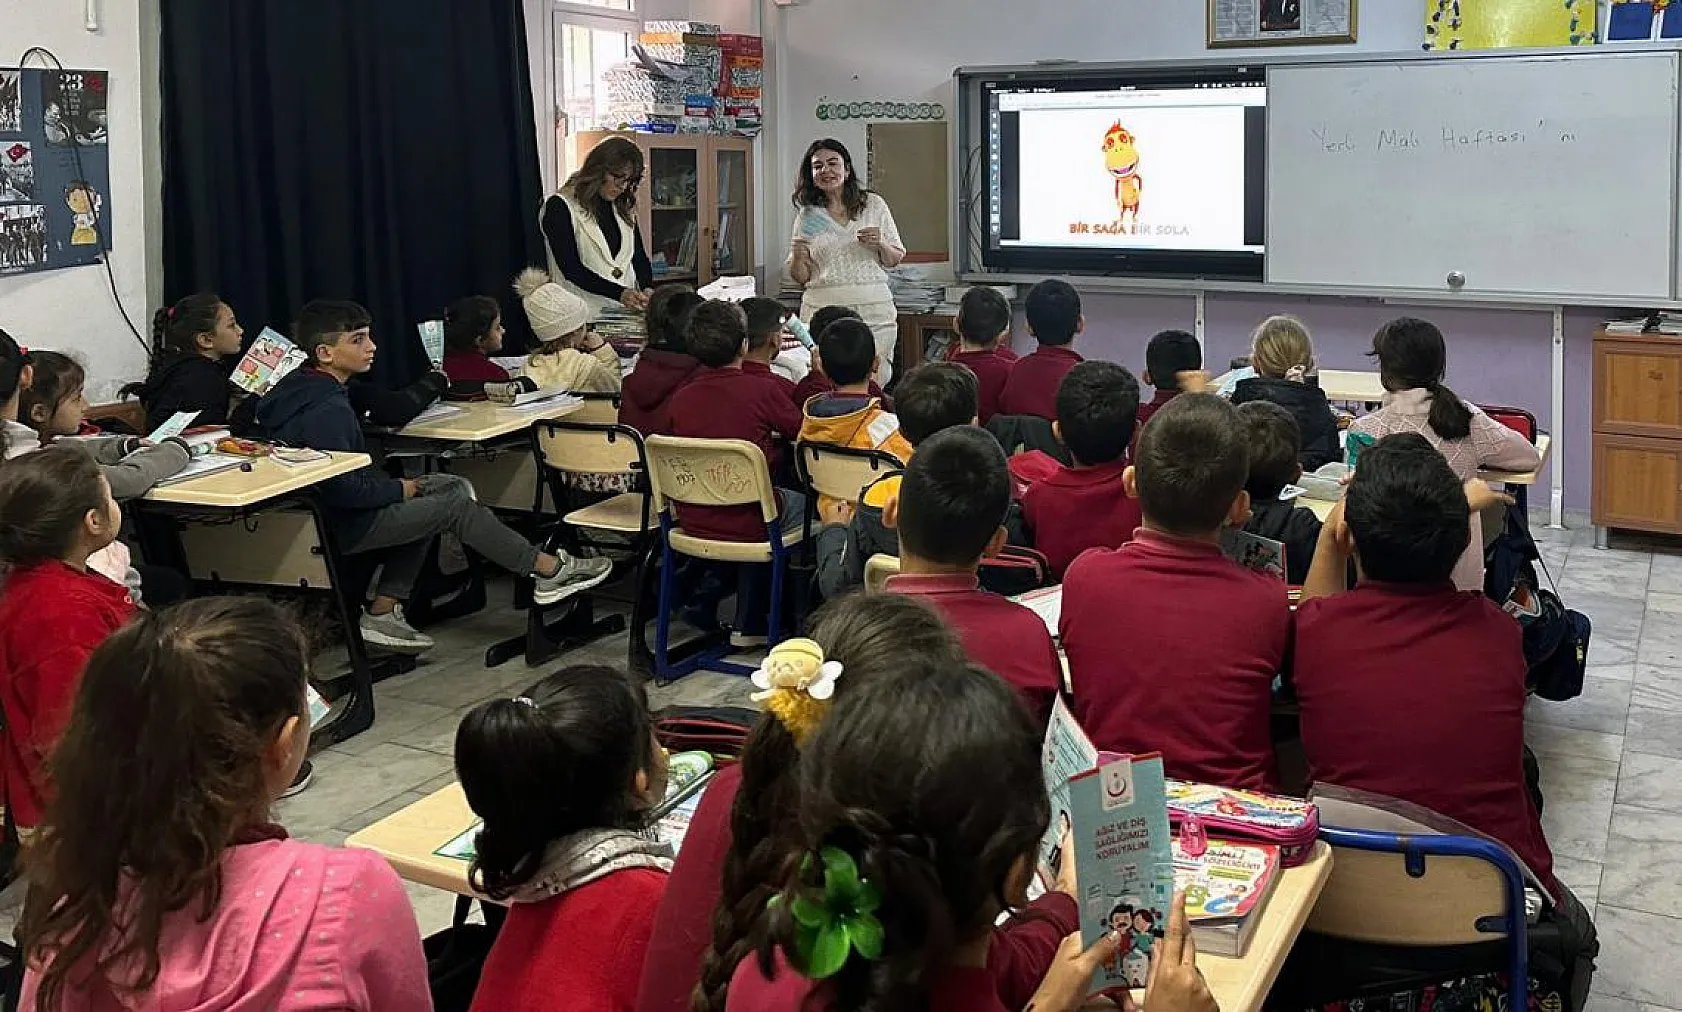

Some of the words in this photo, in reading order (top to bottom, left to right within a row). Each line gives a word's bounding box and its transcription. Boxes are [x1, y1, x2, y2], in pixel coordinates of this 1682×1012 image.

[1068, 220, 1090, 235] BİR
[1092, 220, 1127, 236] SAĞA
[1155, 224, 1190, 237] SOLA
